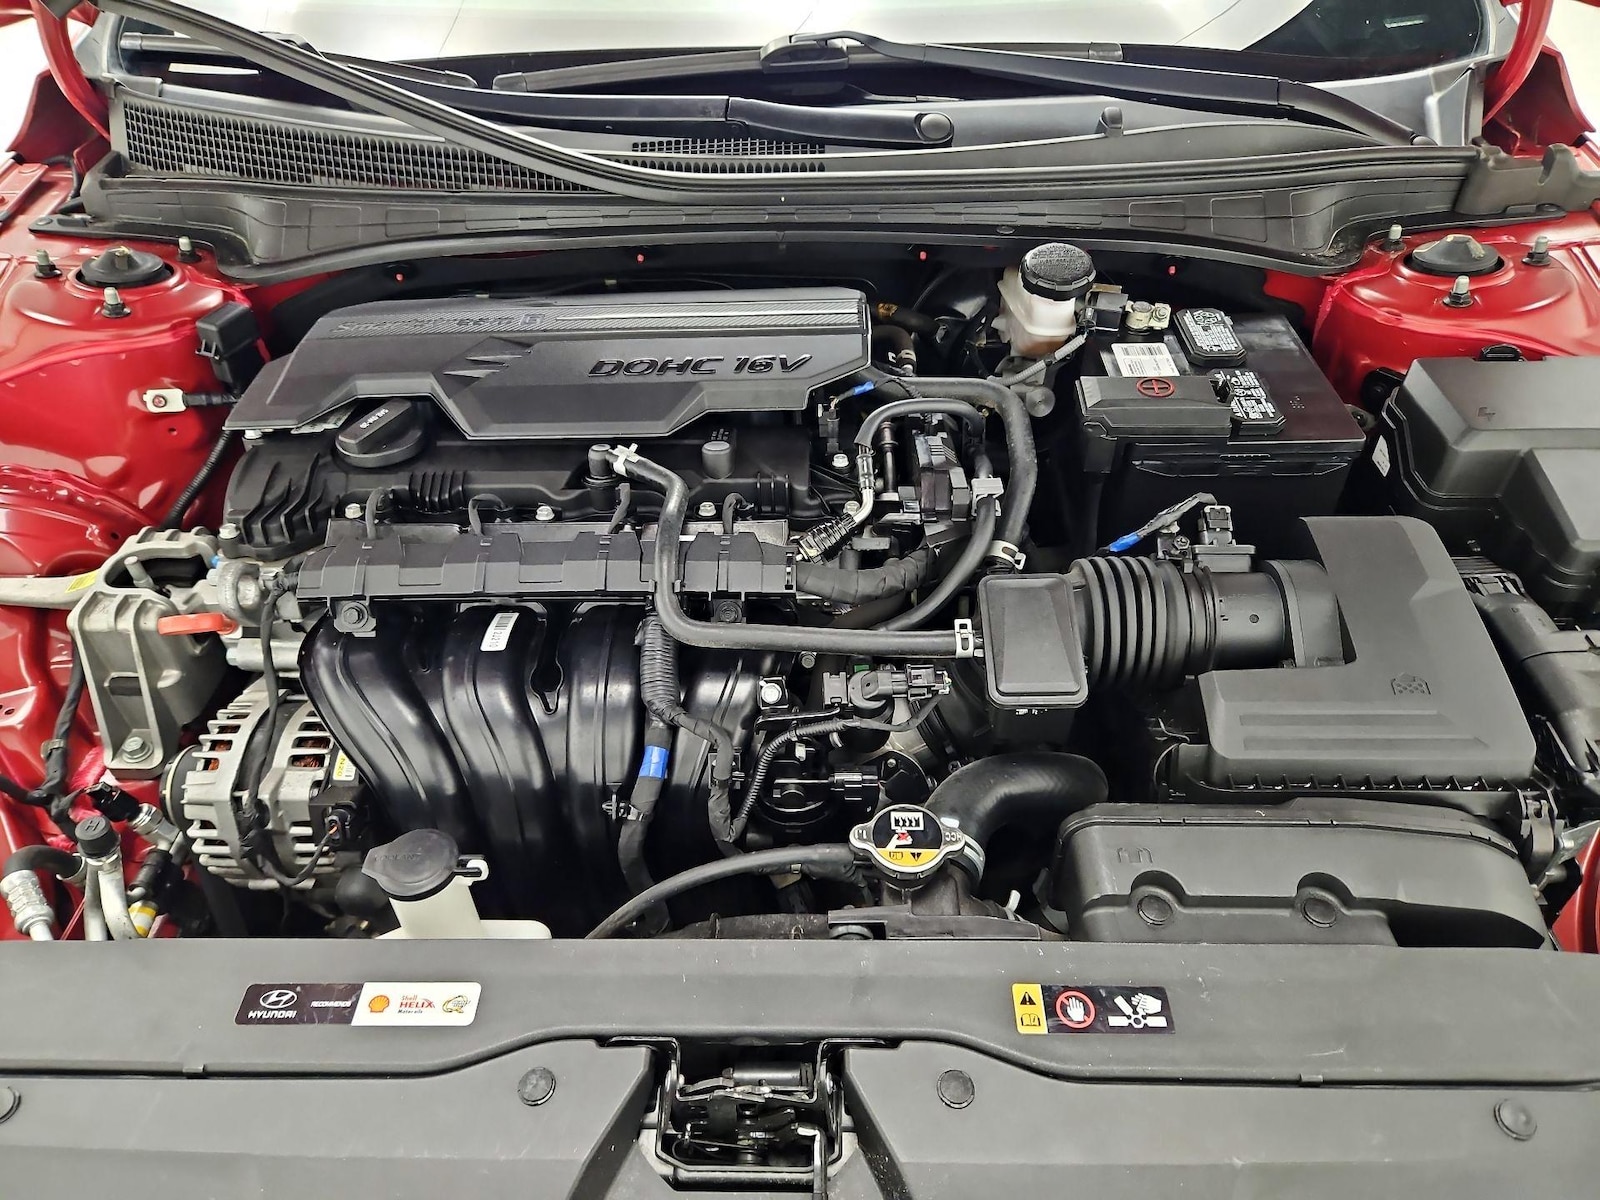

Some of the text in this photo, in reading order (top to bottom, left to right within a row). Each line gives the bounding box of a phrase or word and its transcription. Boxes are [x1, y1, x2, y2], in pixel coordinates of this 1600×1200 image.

[587, 354, 813, 377] DOHC 16V
[85, 820, 101, 831] H
[399, 1001, 434, 1009] HELIX
[247, 1010, 297, 1019] HYUNDAI
